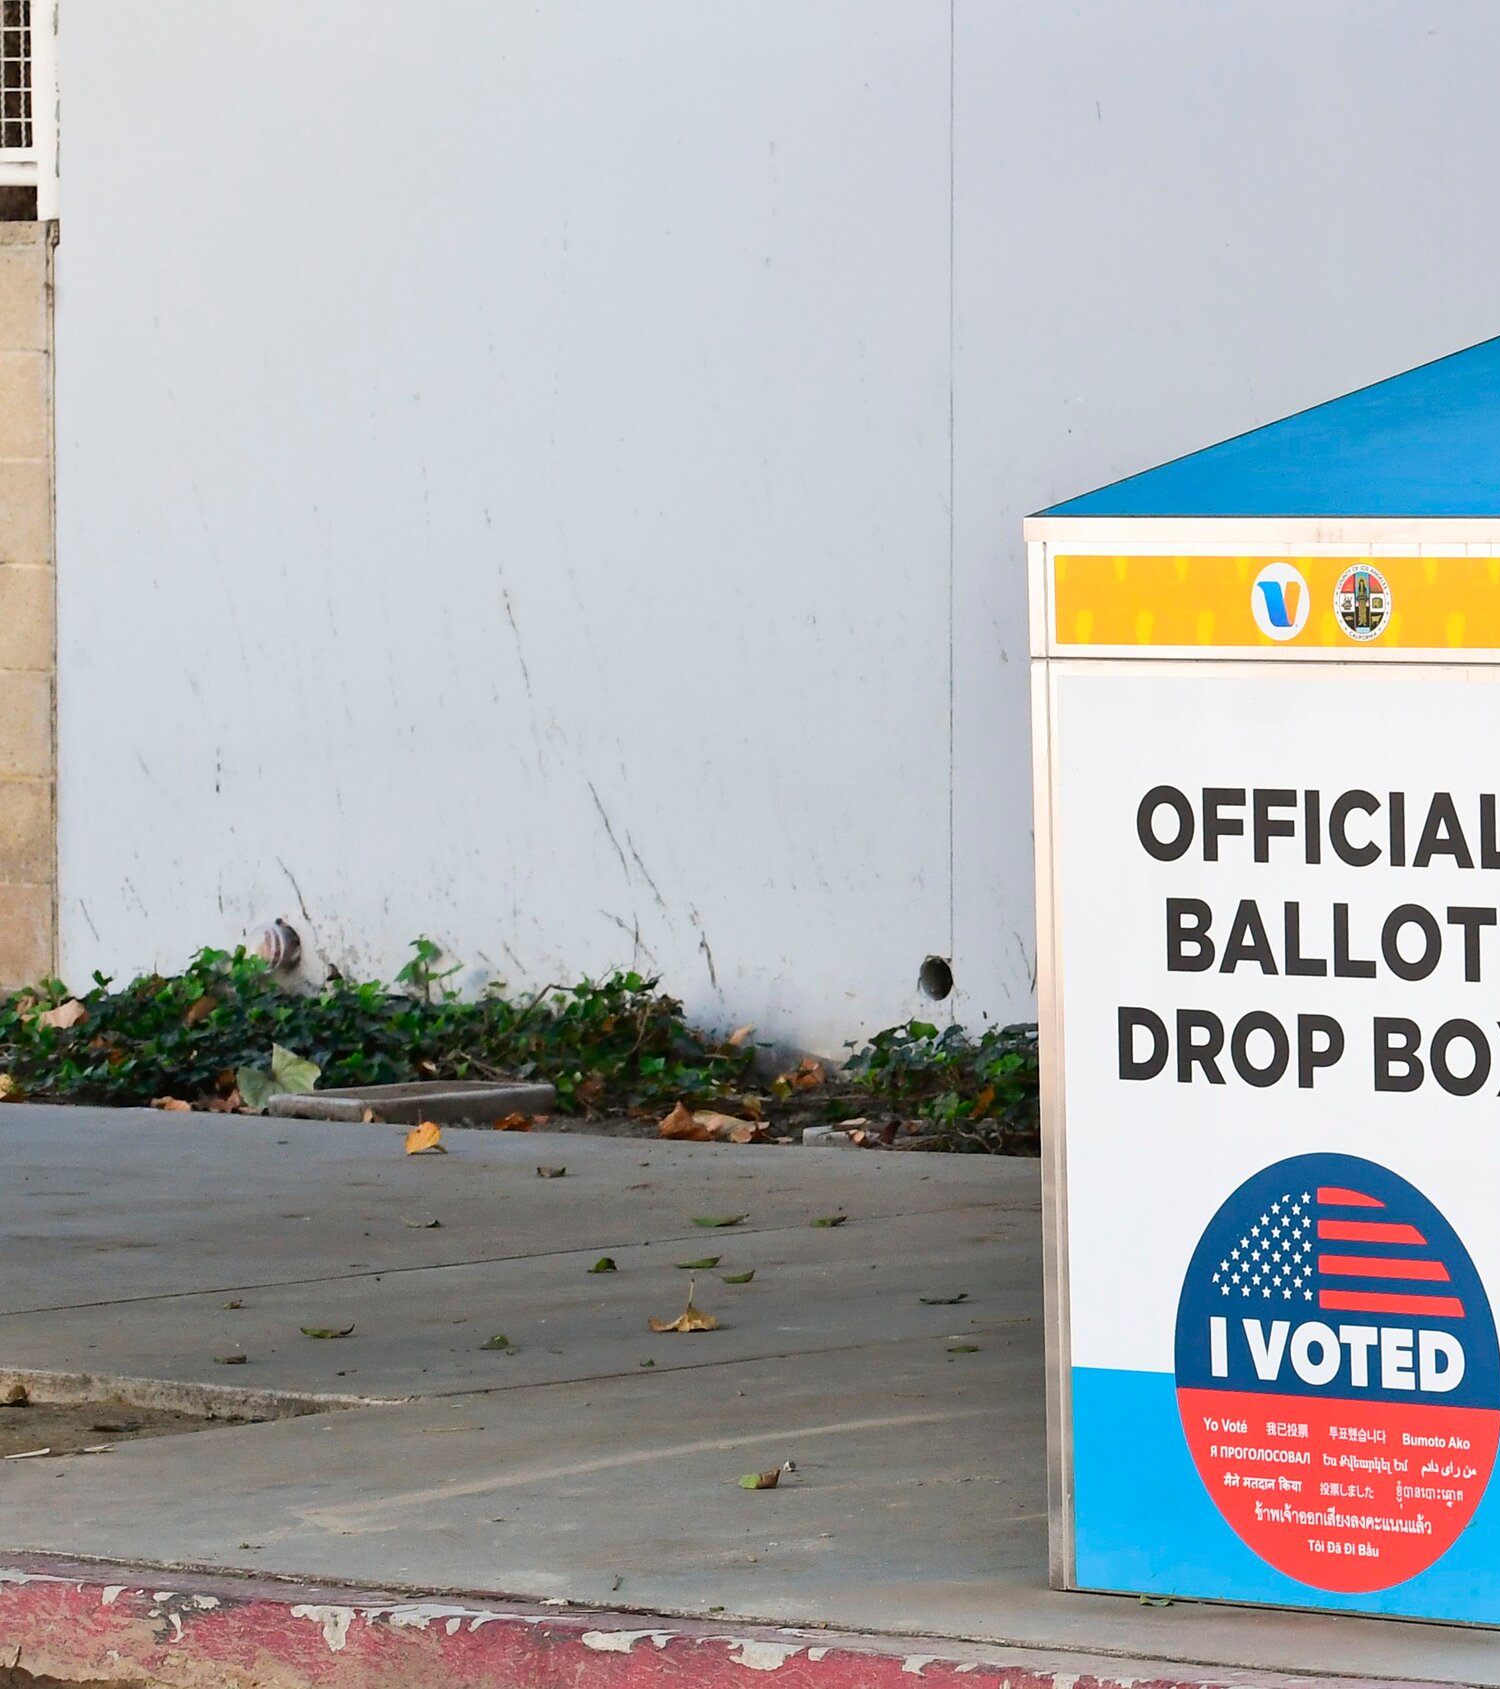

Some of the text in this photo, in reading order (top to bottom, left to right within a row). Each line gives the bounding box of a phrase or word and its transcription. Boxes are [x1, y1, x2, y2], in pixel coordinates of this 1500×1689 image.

[1166, 897, 1497, 982] BALLOT
[1118, 1006, 1344, 1088] DROP
[1210, 1316, 1466, 1393] I VOTED
[1203, 1417, 1248, 1434] Yo Voté
[1266, 1422, 1308, 1438] 我已投票
[1329, 1426, 1386, 1444] 투표했습니다
[1402, 1433, 1470, 1449] Bumoto Ako
[1210, 1445, 1311, 1464] Я ПРОГОЛОСОВАЛ
[1463, 1466, 1477, 1478] من
[1242, 1476, 1276, 1490] मतदान
[1278, 1476, 1302, 1492] किया
[1320, 1482, 1374, 1498] 投票しました
[1255, 1500, 1432, 1534] ข้าพเจ้าออกเสียงลงคะแนนแล้ว
[1308, 1540, 1324, 1552] Tôi
[1327, 1541, 1341, 1554] Đã
[1344, 1543, 1355, 1555] Đi
